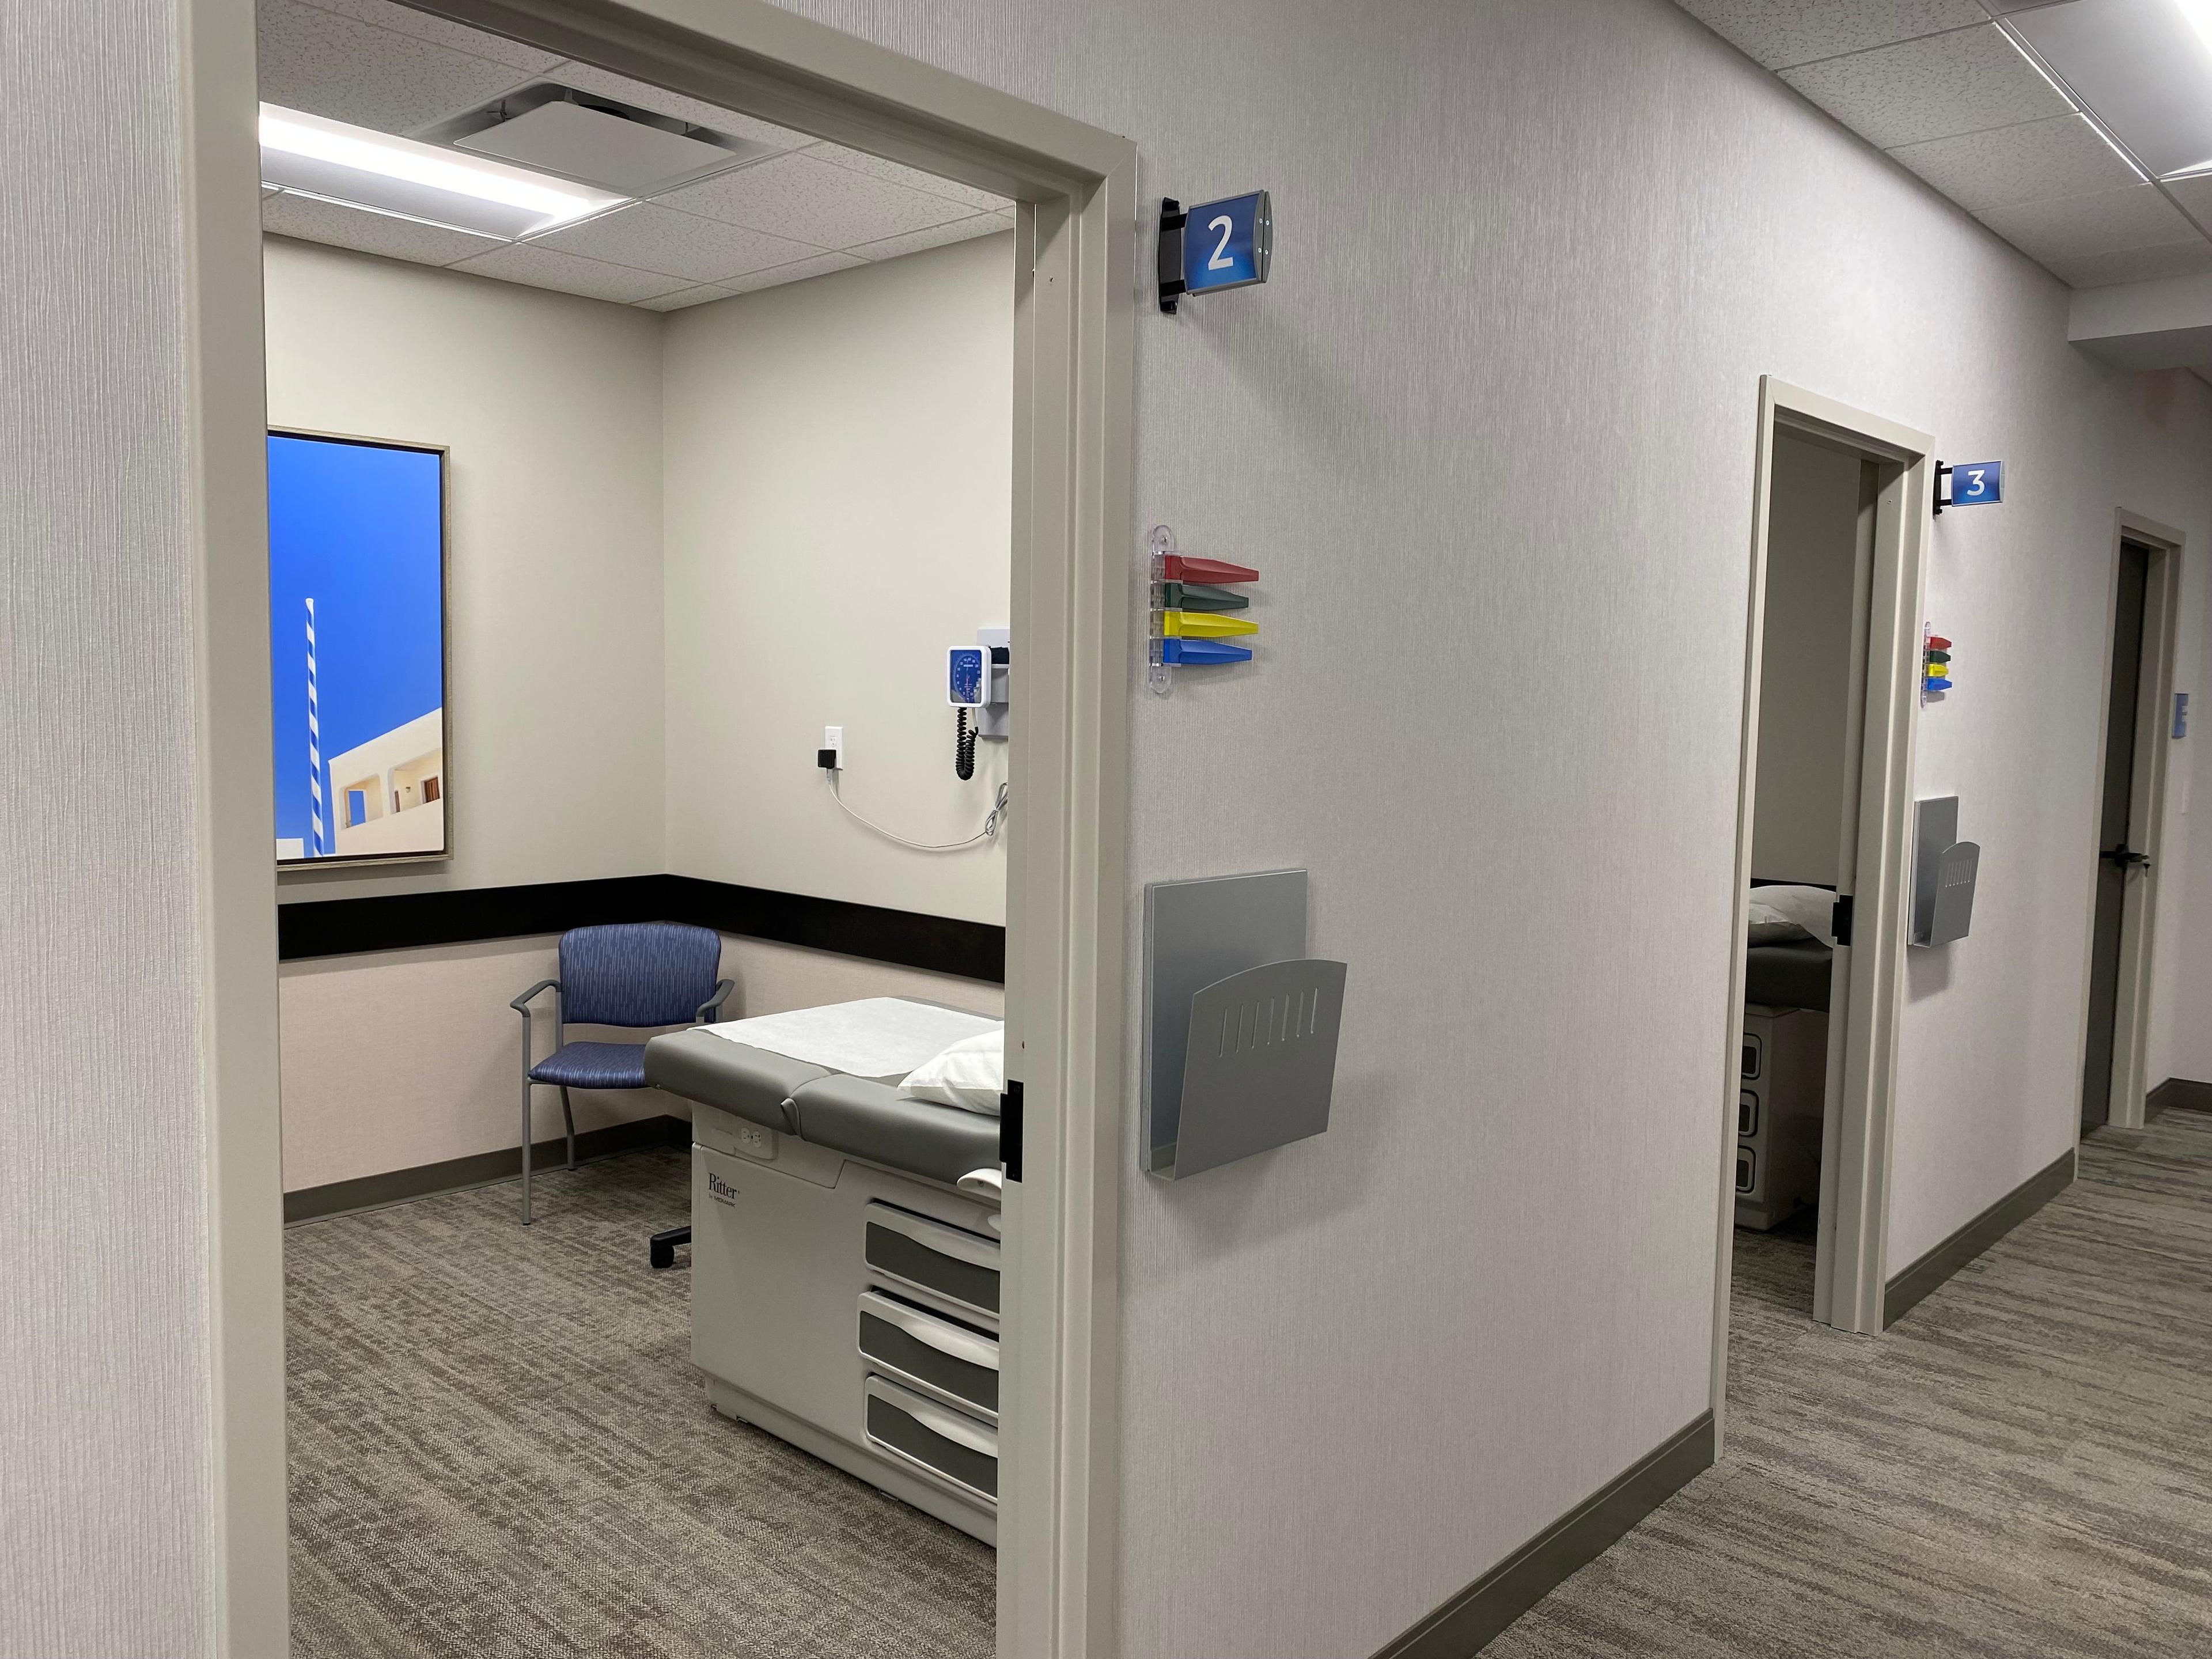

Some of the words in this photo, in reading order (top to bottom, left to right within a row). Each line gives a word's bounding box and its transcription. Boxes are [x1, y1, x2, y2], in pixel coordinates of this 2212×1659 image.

[1208, 215, 1234, 271] 2
[1967, 469, 1986, 496] 3
[708, 1172, 737, 1199] Ritter
